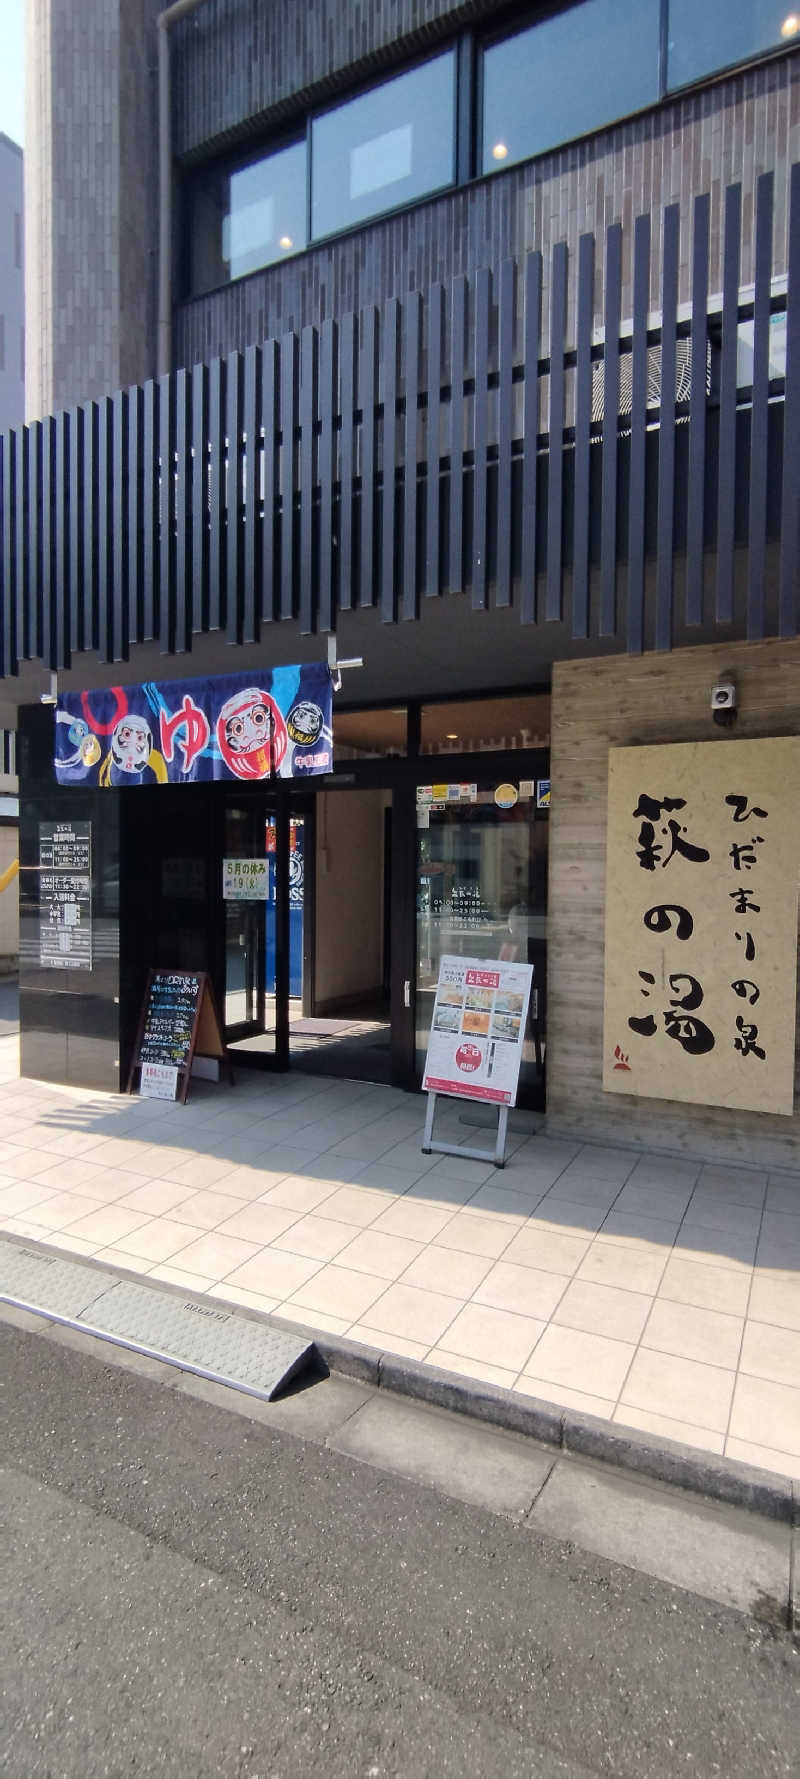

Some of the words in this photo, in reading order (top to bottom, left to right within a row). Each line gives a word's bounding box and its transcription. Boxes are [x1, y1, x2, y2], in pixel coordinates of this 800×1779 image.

[160, 695, 209, 772] ゆ
[227, 863, 266, 875] 5月の休み
[628, 793, 715, 1055] 萩の湯
[725, 794, 769, 1060] ひだまりの泉
